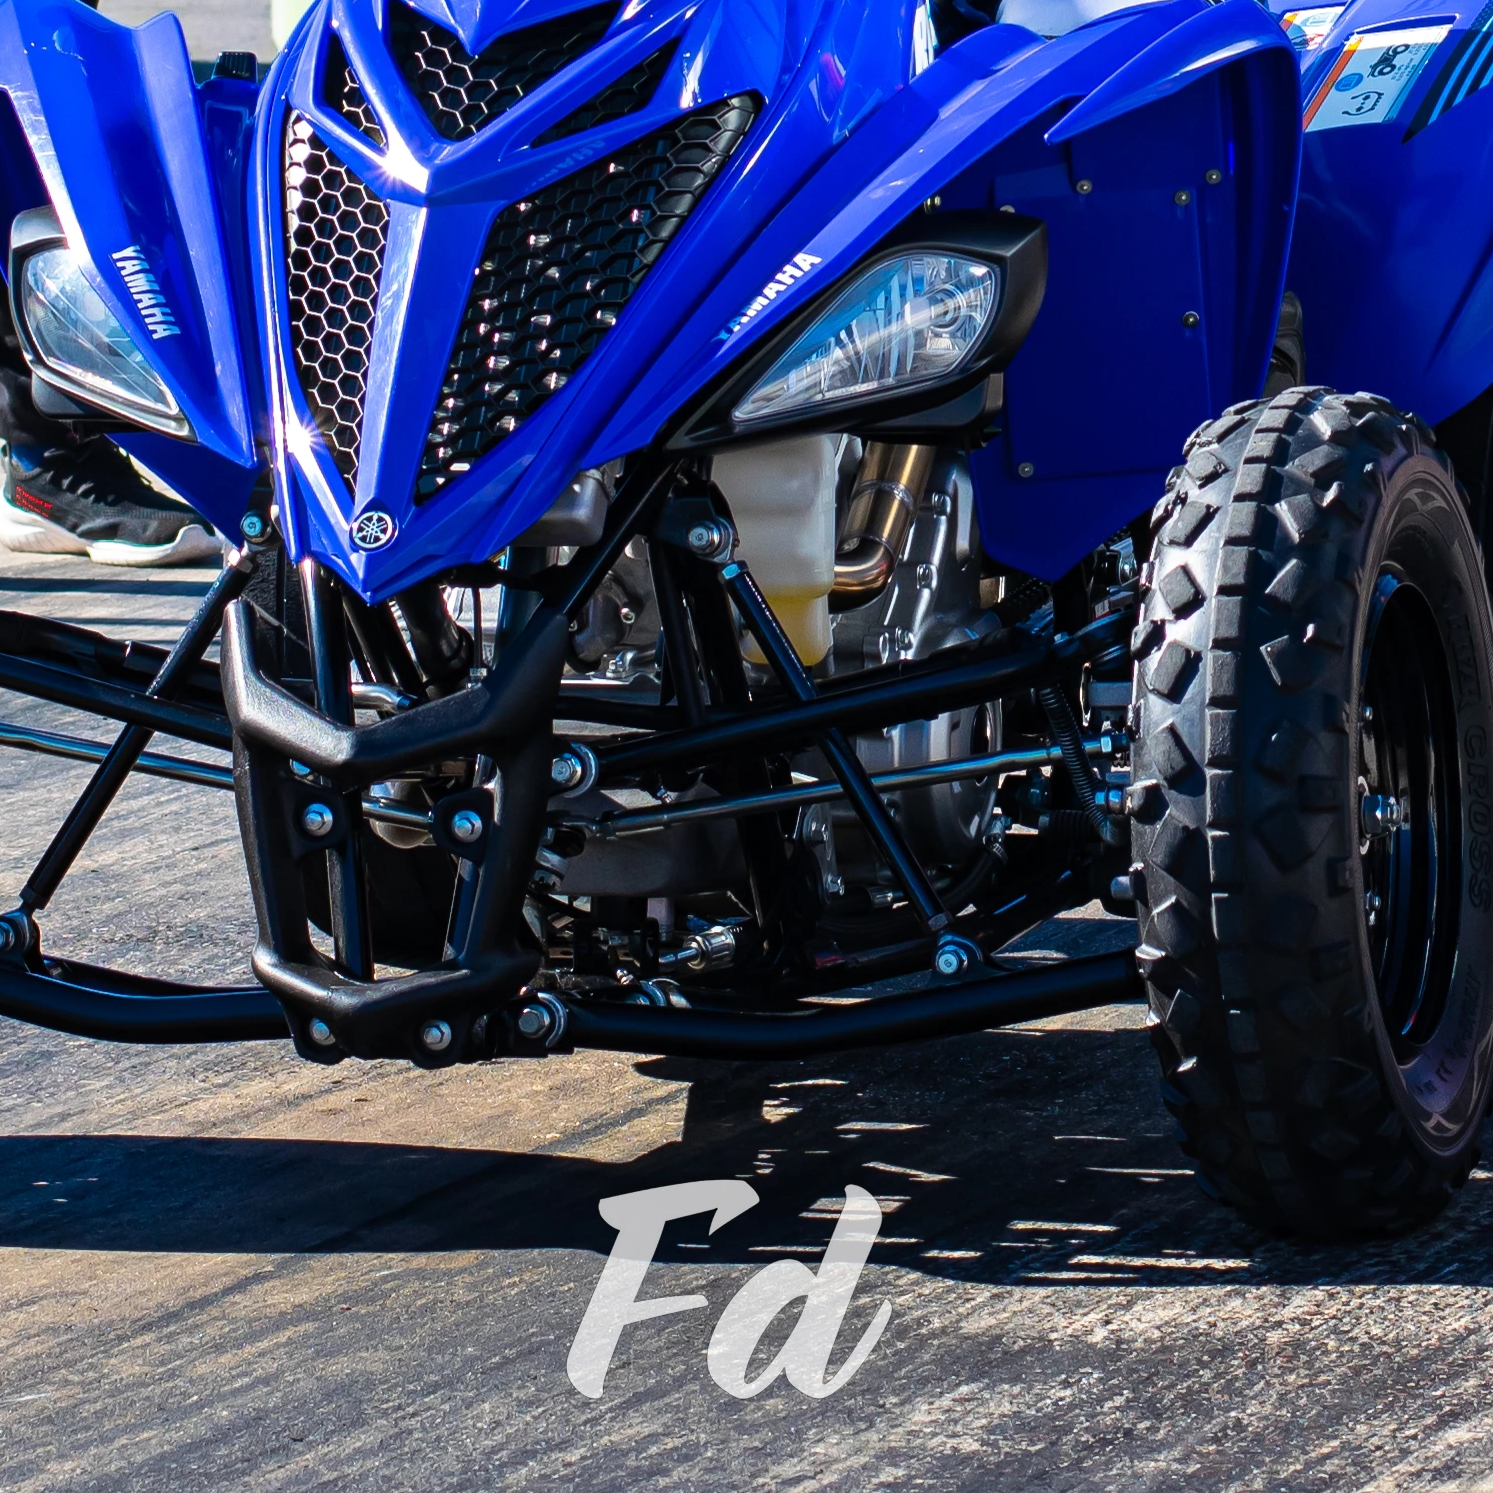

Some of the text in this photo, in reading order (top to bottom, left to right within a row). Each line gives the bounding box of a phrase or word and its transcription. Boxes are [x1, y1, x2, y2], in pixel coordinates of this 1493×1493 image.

[111, 245, 182, 340] YAMAHA
[710, 252, 823, 344] YAMAHA
[1463, 724, 1492, 914] CROSS
